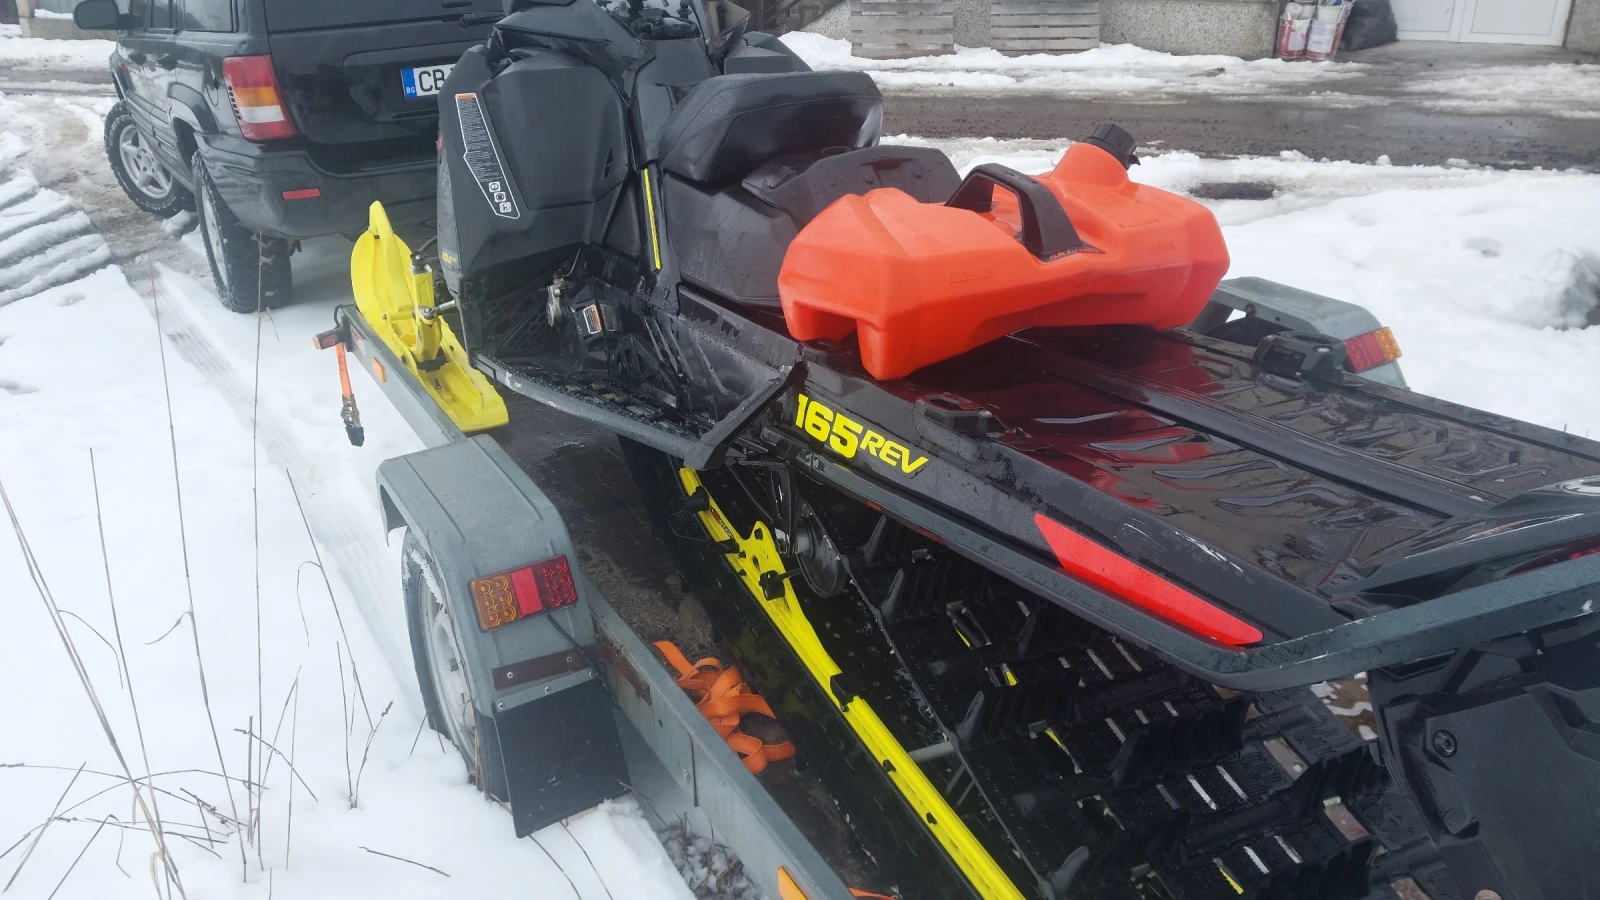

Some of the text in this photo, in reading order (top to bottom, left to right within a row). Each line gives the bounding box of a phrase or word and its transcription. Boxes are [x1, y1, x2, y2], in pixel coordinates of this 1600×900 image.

[405, 86, 416, 94] BG
[418, 69, 446, 92] CB
[947, 265, 993, 284] ESSENCE
[795, 393, 929, 474] 165 REV
